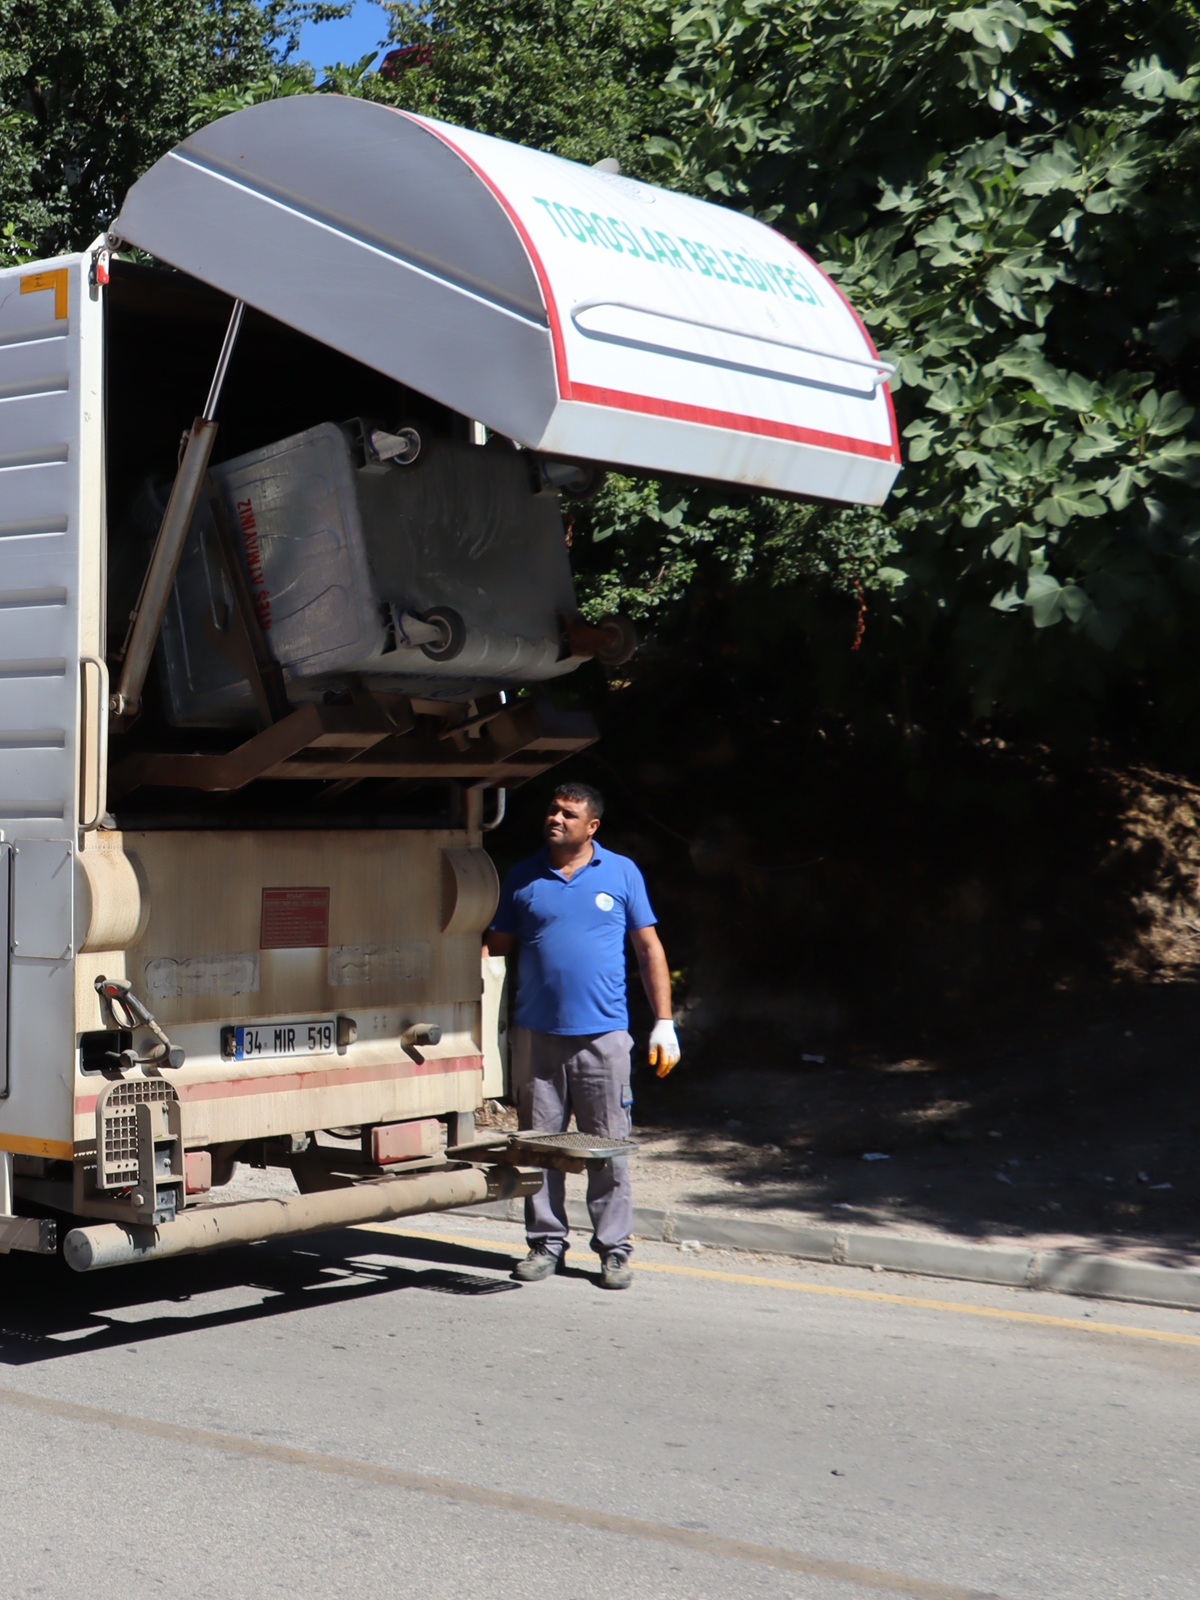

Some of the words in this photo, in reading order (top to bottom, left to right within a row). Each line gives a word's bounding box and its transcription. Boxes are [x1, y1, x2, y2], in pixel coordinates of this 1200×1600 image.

[532, 196, 693, 272] TOROSLAR
[678, 237, 826, 308] BELEDİYESİ
[237, 498, 265, 585] ATMAYINIZ
[245, 1030, 262, 1055] 34
[273, 1028, 296, 1053] MIR
[307, 1026, 332, 1050] 519
